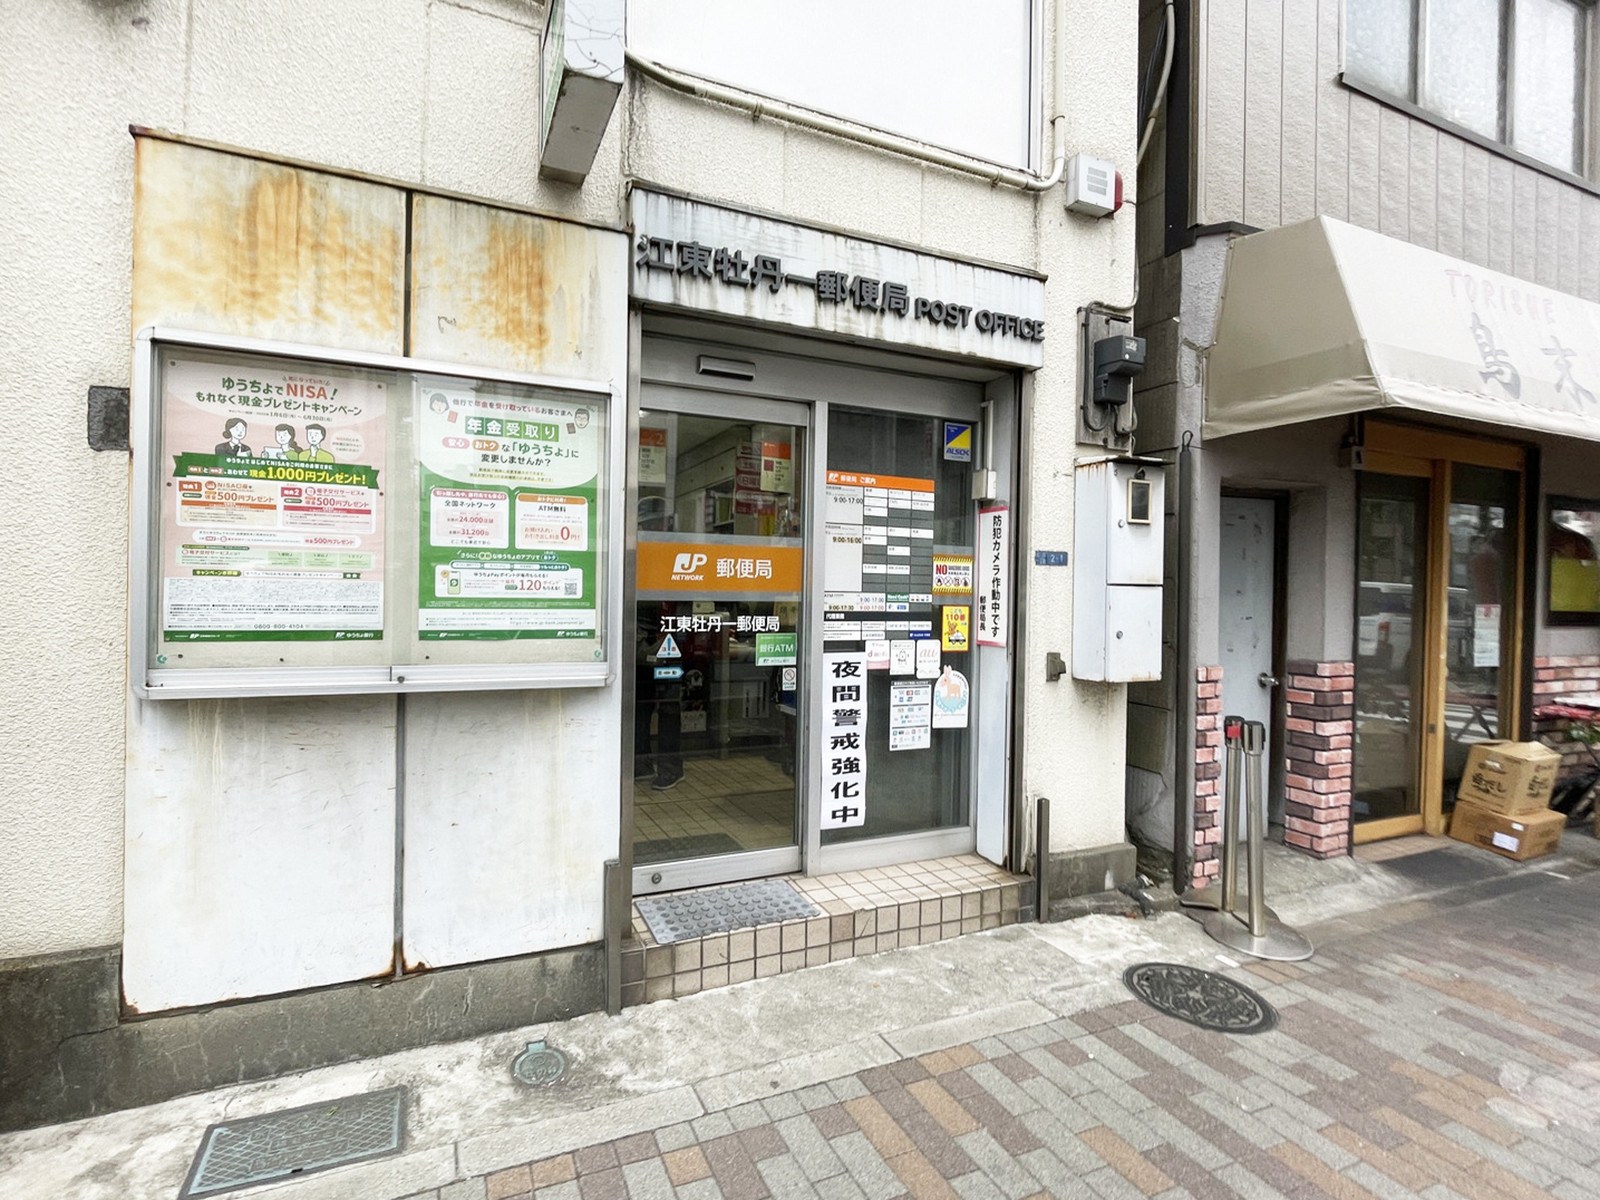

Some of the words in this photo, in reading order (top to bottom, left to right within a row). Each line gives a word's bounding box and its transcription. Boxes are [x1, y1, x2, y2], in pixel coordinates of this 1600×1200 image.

[636, 233, 910, 315] 江東牡丹一郵便局
[916, 297, 972, 329] POST
[975, 310, 1045, 341] OFFICE
[222, 377, 338, 400] ゆうちょでNISA!
[196, 391, 362, 416] もれなく現金プレゼントキャンペーン
[467, 417, 555, 440] 年金受取り
[481, 453, 551, 467] 変更しませんか?
[716, 558, 773, 579] 郵便局
[935, 564, 948, 575] NO
[991, 515, 1002, 638] 防犯カメラ作動中です
[660, 615, 780, 633] 江東牡丹一郵便局
[830, 660, 861, 823] 夜間警戒強化中
